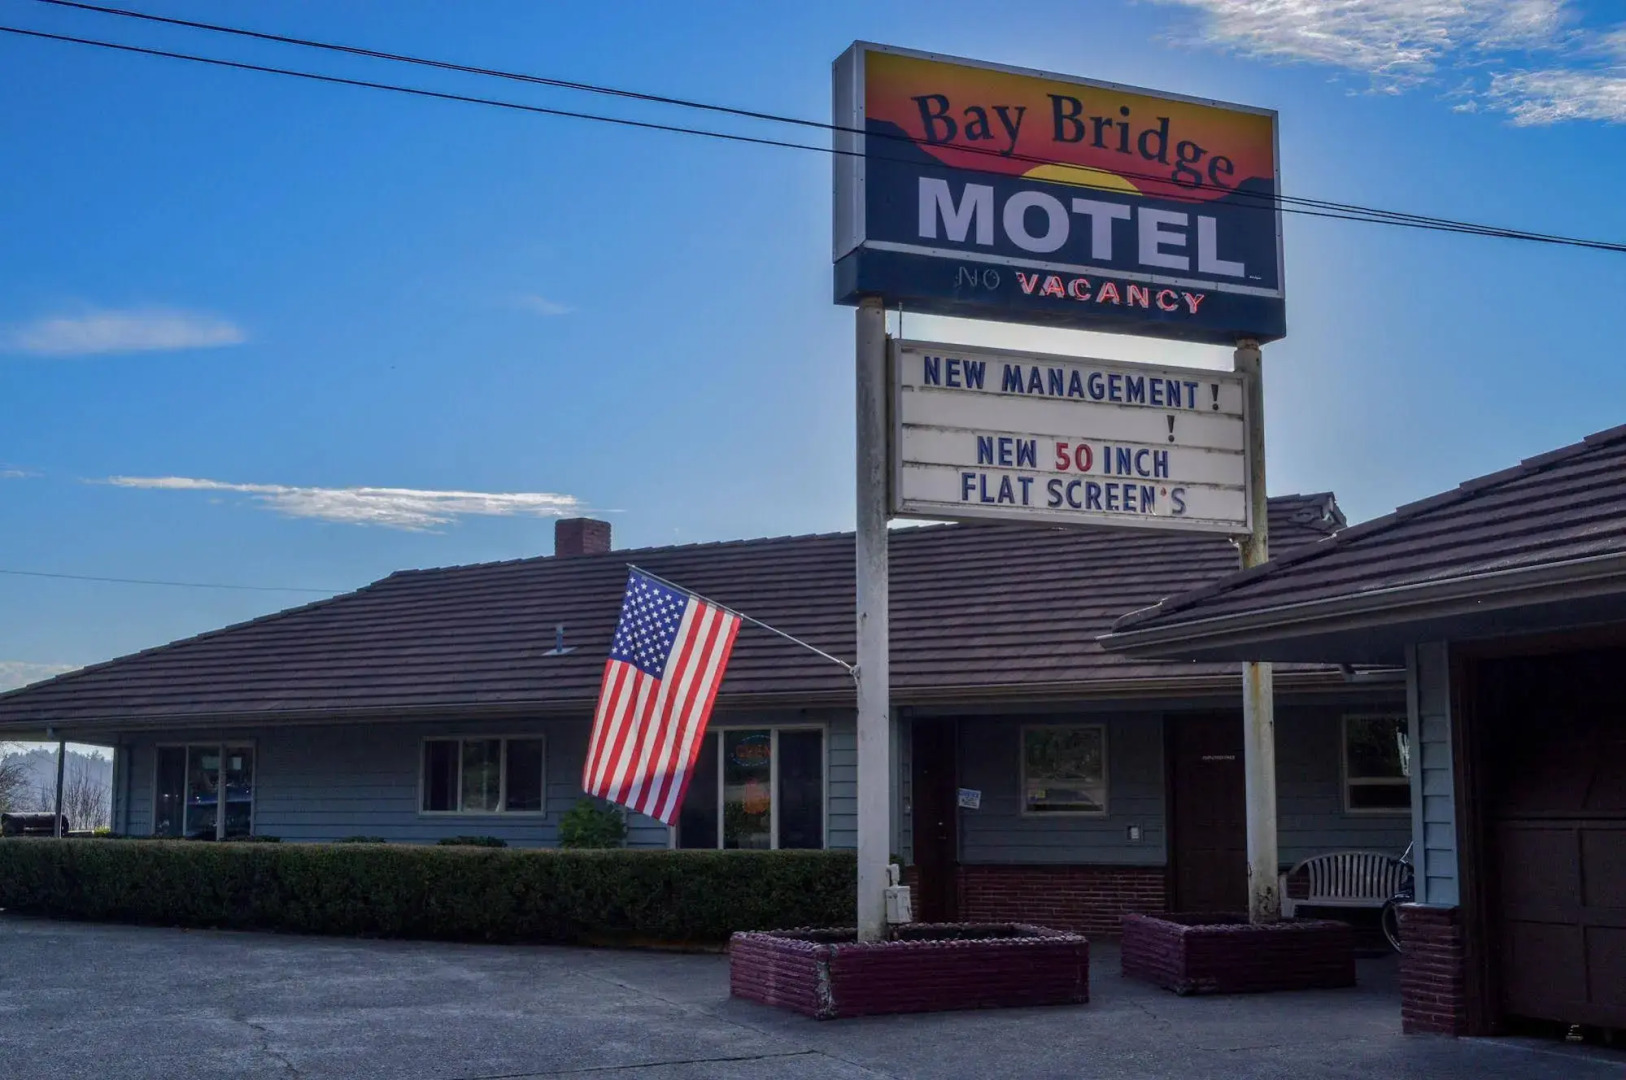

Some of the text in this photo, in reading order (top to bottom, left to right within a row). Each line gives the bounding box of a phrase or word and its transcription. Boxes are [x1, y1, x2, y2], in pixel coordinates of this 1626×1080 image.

[912, 94, 1234, 189] Bay Bridge
[918, 176, 1245, 278] MOTEL
[954, 266, 1205, 314] NO VACANCY
[923, 355, 986, 389] NEW
[976, 435, 1169, 478] NEW 50 INCH
[961, 472, 1187, 515] FLAT SCREEN'S
